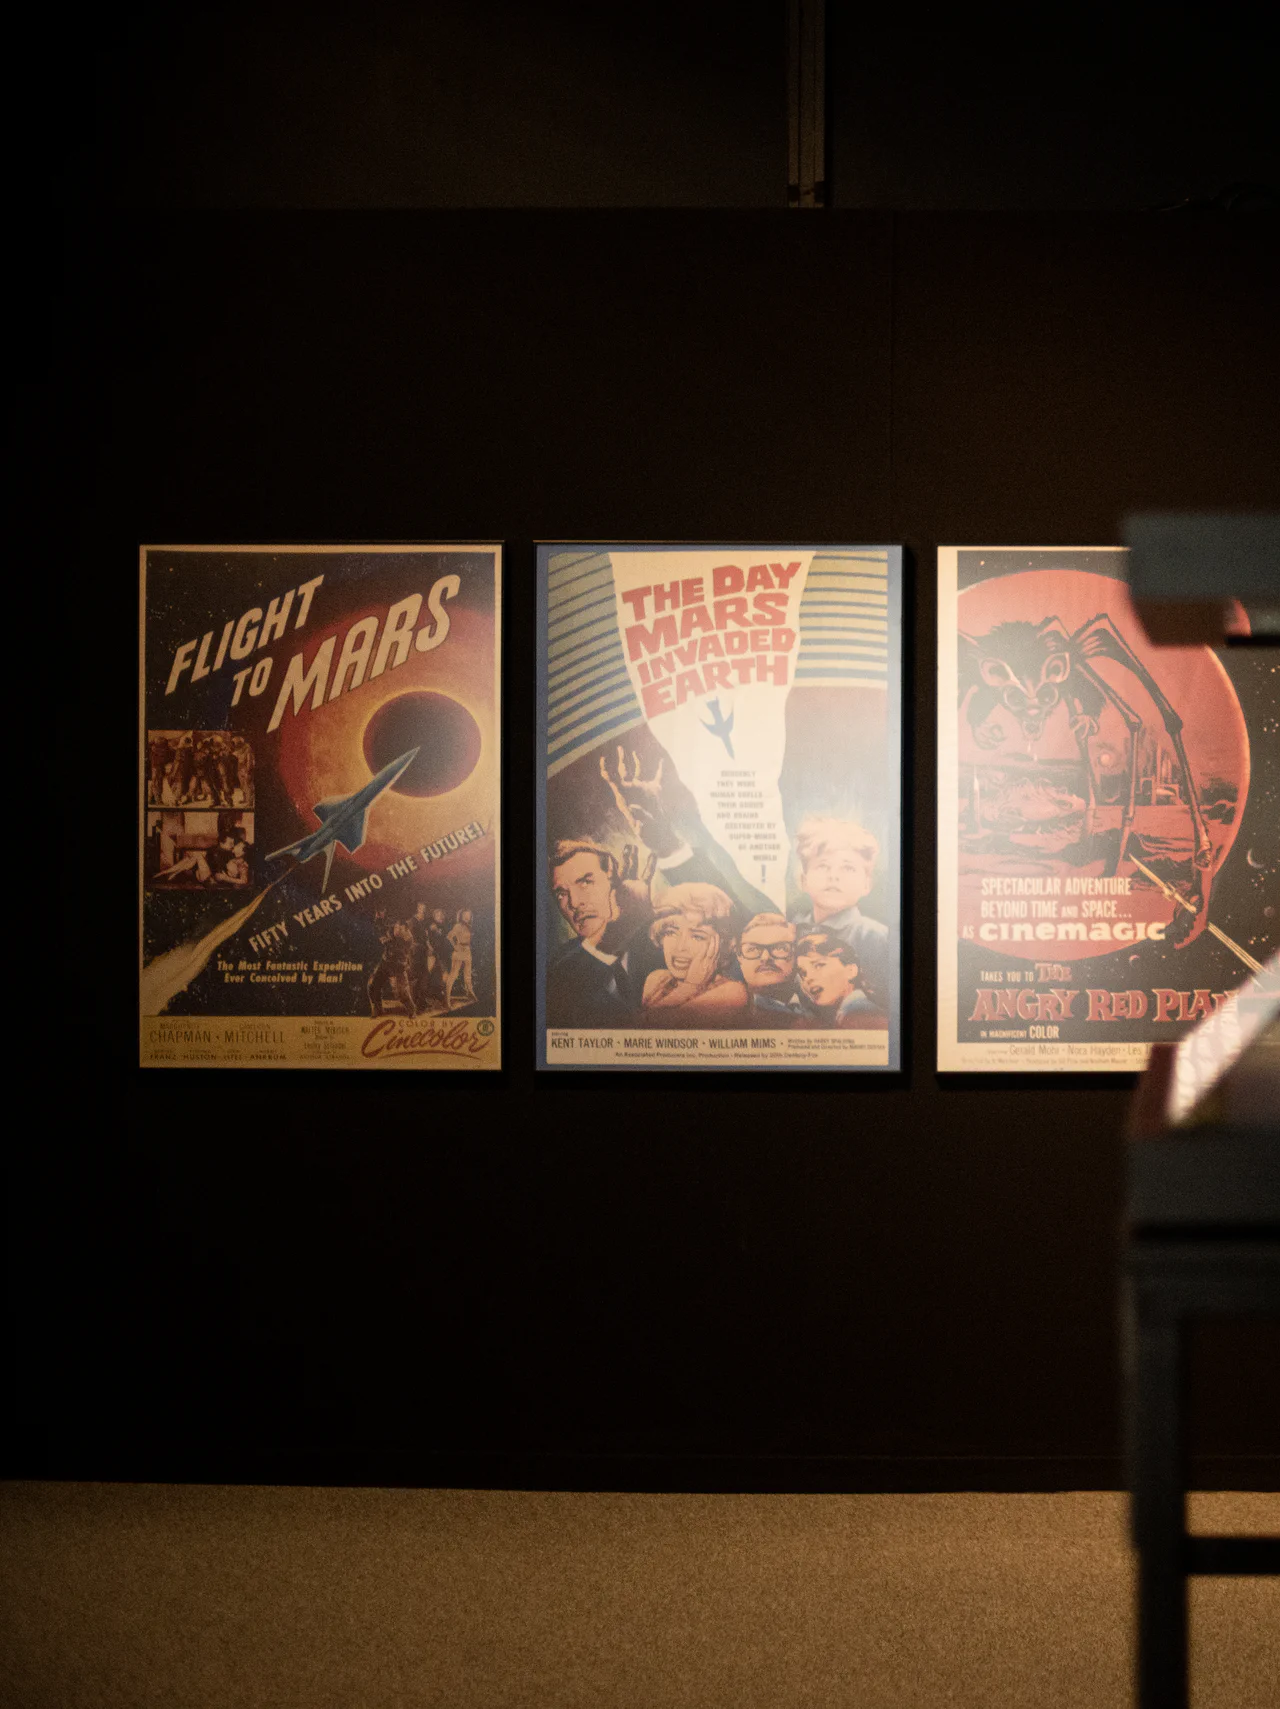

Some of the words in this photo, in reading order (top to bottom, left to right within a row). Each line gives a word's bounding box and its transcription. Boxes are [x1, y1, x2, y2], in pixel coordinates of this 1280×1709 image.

[621, 576, 704, 622] THE
[712, 562, 802, 599] DAY
[164, 574, 325, 696] FLIGHT
[624, 592, 789, 662] MARS
[230, 657, 274, 708] TO
[266, 573, 461, 733] MARS
[637, 627, 796, 684] INVADED
[640, 655, 789, 720] EARTH
[248, 920, 289, 954] FIFTY
[293, 894, 343, 928] YEARS
[344, 873, 384, 903] INTO
[385, 854, 418, 881] THE
[419, 821, 485, 864] FUTURE!
[981, 877, 1061, 896] SPECTACULAR
[1064, 877, 1133, 896] ADVENTURE
[981, 900, 1028, 919] BEYOND
[1031, 900, 1059, 919] TIME
[1061, 905, 1079, 919] AND
[962, 925, 975, 940] AS
[217, 961, 234, 971] The
[238, 961, 262, 971] Most
[265, 961, 308, 971] Fantastic
[313, 961, 363, 973] Expedition
[980, 970, 1004, 982] TAKES
[1007, 970, 1022, 982] YOU
[1024, 970, 1035, 982] TO
[224, 973, 245, 984] Ever
[250, 973, 297, 983] Conceived
[302, 973, 313, 985] by
[318, 973, 343, 983] Man!
[967, 988, 1081, 1022] ANGRY
[1085, 988, 1149, 1022] RED
[398, 1020, 435, 1028] COLOR
[1029, 1025, 1060, 1039] COLOR
[150, 1030, 211, 1043] CHAPMAN
[224, 1030, 285, 1043] MITCHELL
[361, 1019, 490, 1058] Cinecolor
[551, 1038, 575, 1049] KENT
[578, 1037, 614, 1049] TAYLOR
[623, 1038, 652, 1049] MARIE
[655, 1038, 699, 1049] WINDSOR
[708, 1038, 748, 1049] WILLIAM
[751, 1038, 777, 1049] MIMS
[1009, 1045, 1036, 1056] Gerald
[1090, 1045, 1121, 1058] Hayden
